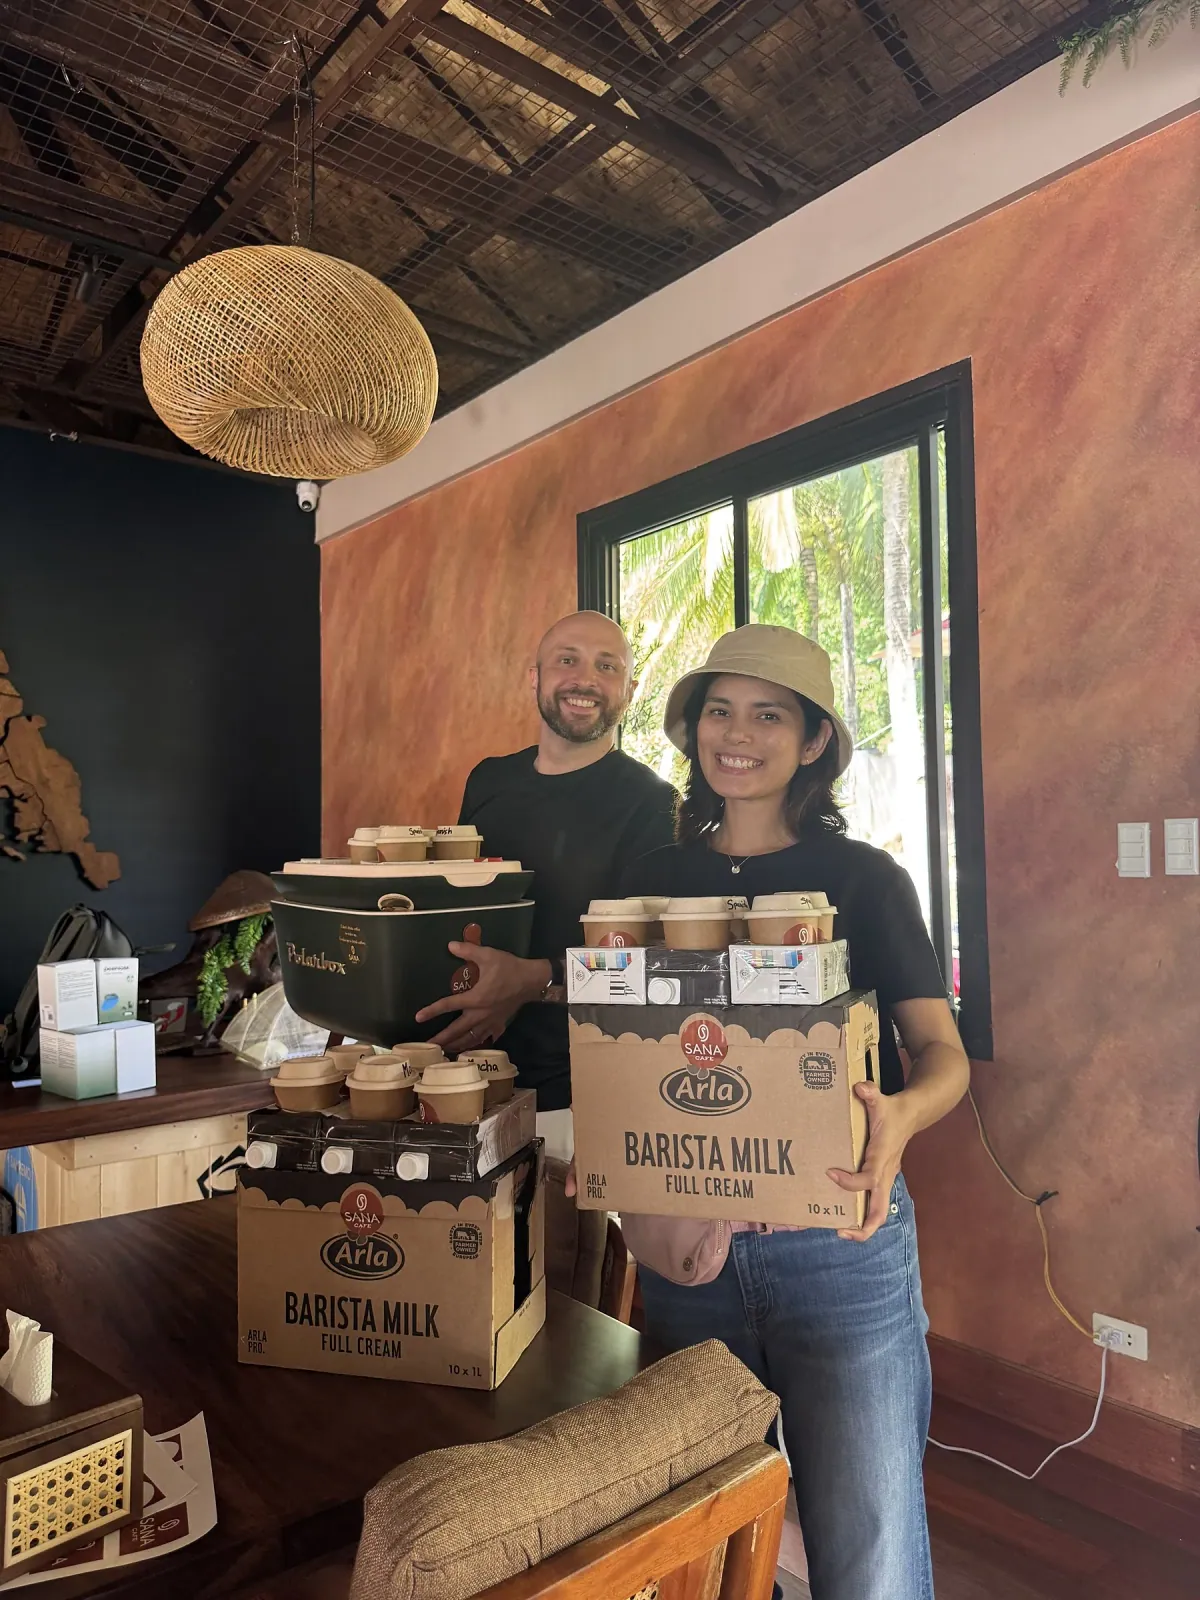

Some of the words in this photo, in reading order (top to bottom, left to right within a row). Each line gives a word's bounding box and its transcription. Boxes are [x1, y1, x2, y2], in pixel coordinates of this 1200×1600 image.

[286, 941, 347, 975] Polarbox
[453, 981, 472, 991] SAN
[684, 1042, 724, 1057] SANA
[676, 1075, 734, 1101] Arla
[624, 1131, 725, 1172] BARISTA
[730, 1136, 796, 1176] MILK
[586, 1172, 607, 1187] ARLA
[665, 1174, 700, 1195] FULL
[704, 1176, 755, 1199] CREAM
[587, 1186, 606, 1199] PRO.
[344, 1211, 381, 1223] SANA
[807, 1203, 821, 1214] 10
[823, 1207, 831, 1215] x
[833, 1205, 846, 1216] 1L
[335, 1241, 389, 1267] Arla
[285, 1291, 377, 1333] BARISTA
[383, 1300, 440, 1339] MILK
[247, 1328, 268, 1343] ARLA
[248, 1342, 266, 1355] PRO.
[321, 1333, 353, 1354] FULL
[357, 1336, 402, 1360] CREAM
[448, 1364, 460, 1375] 10
[472, 1366, 482, 1377] 1L
[140, 1517, 156, 1548] SANA
